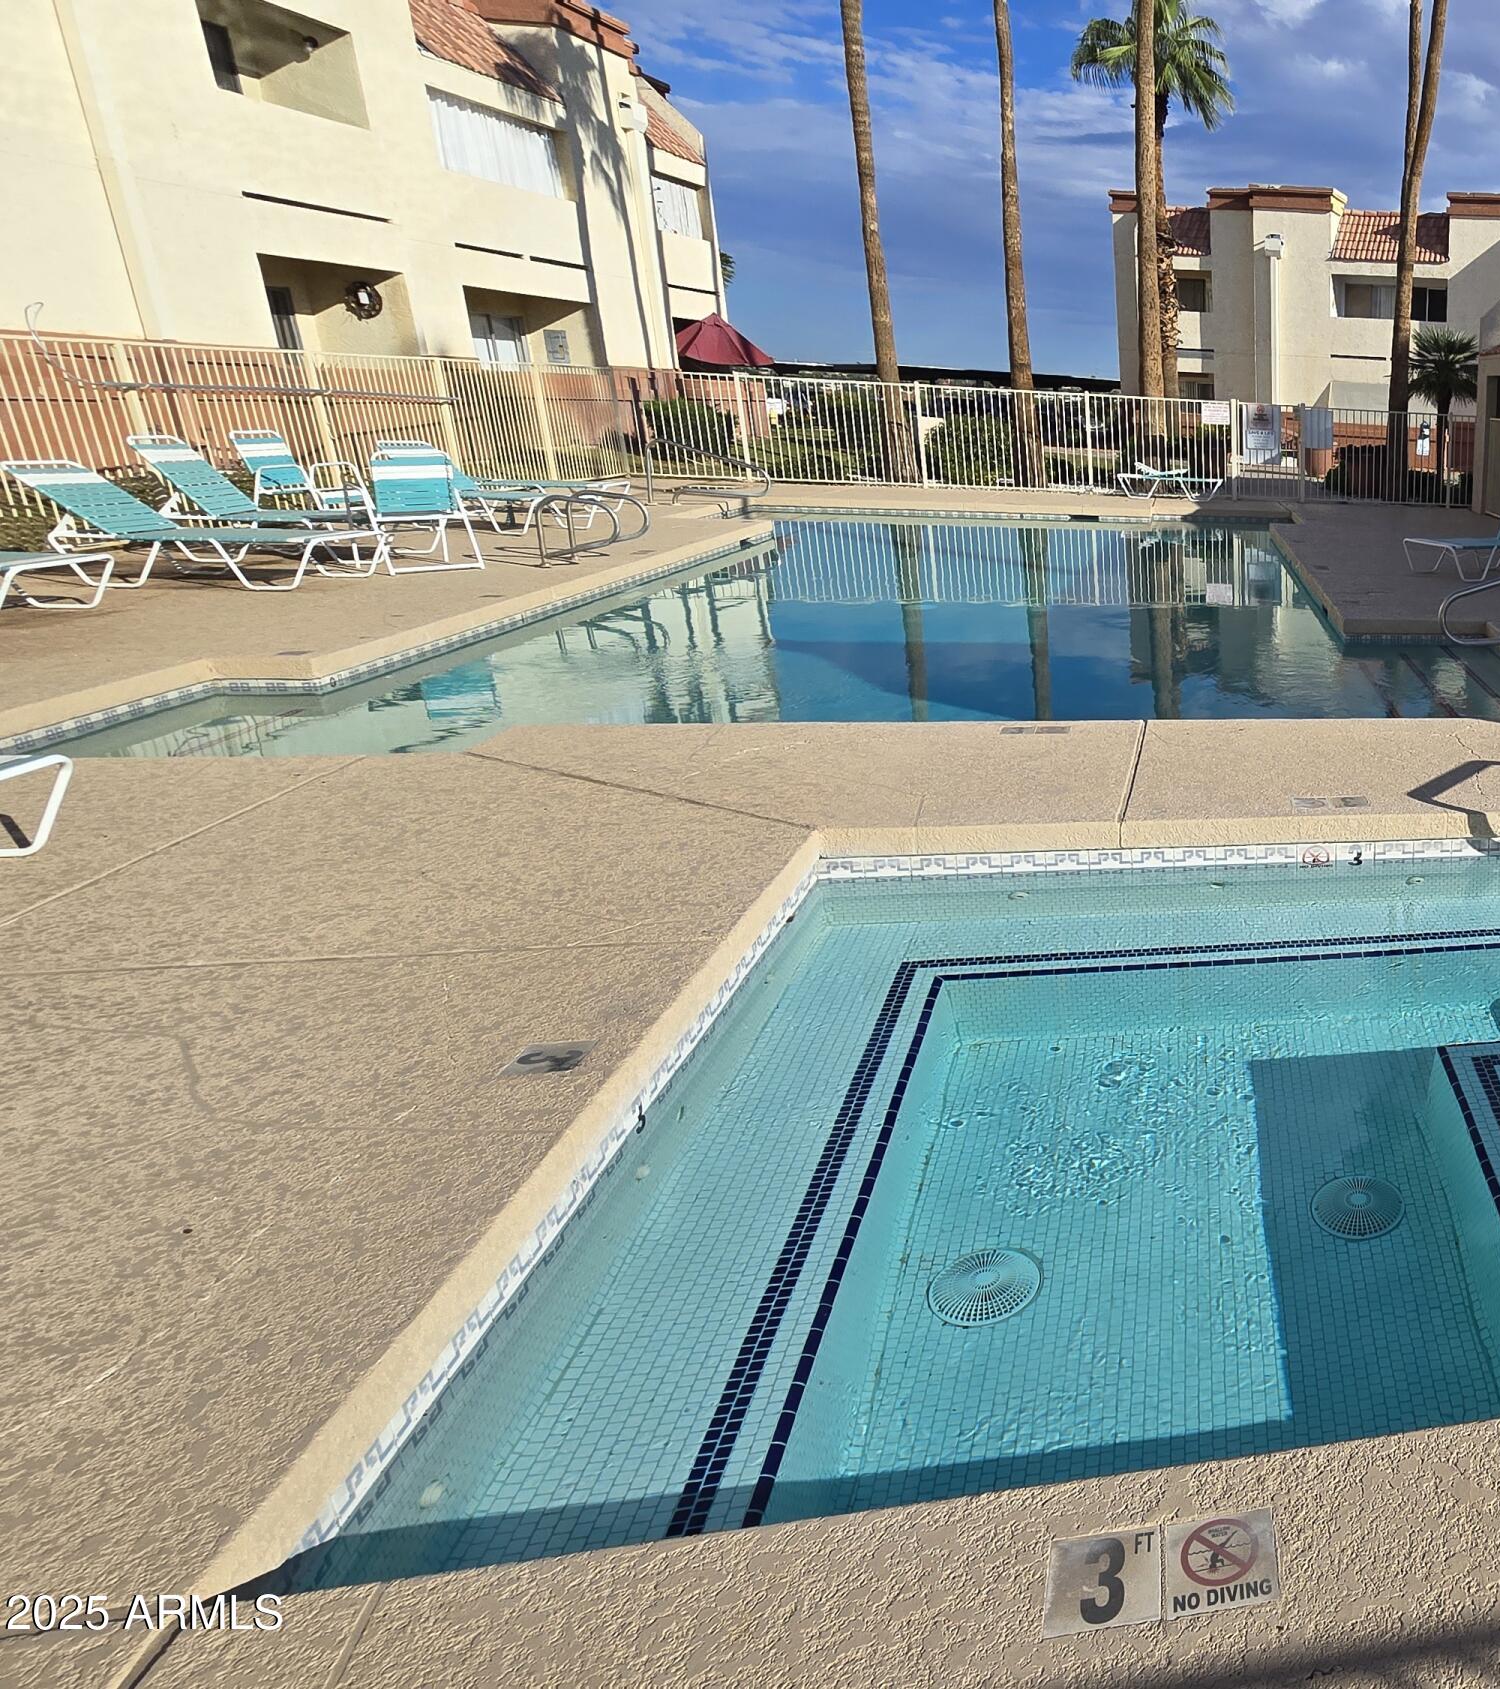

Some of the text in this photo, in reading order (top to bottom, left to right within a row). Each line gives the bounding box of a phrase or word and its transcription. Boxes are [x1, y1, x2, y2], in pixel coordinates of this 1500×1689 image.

[1347, 844, 1363, 866] 3
[631, 1094, 646, 1135] 3
[1079, 1532, 1155, 1625] 3 FT
[1172, 1578, 1273, 1613] NO DIVING
